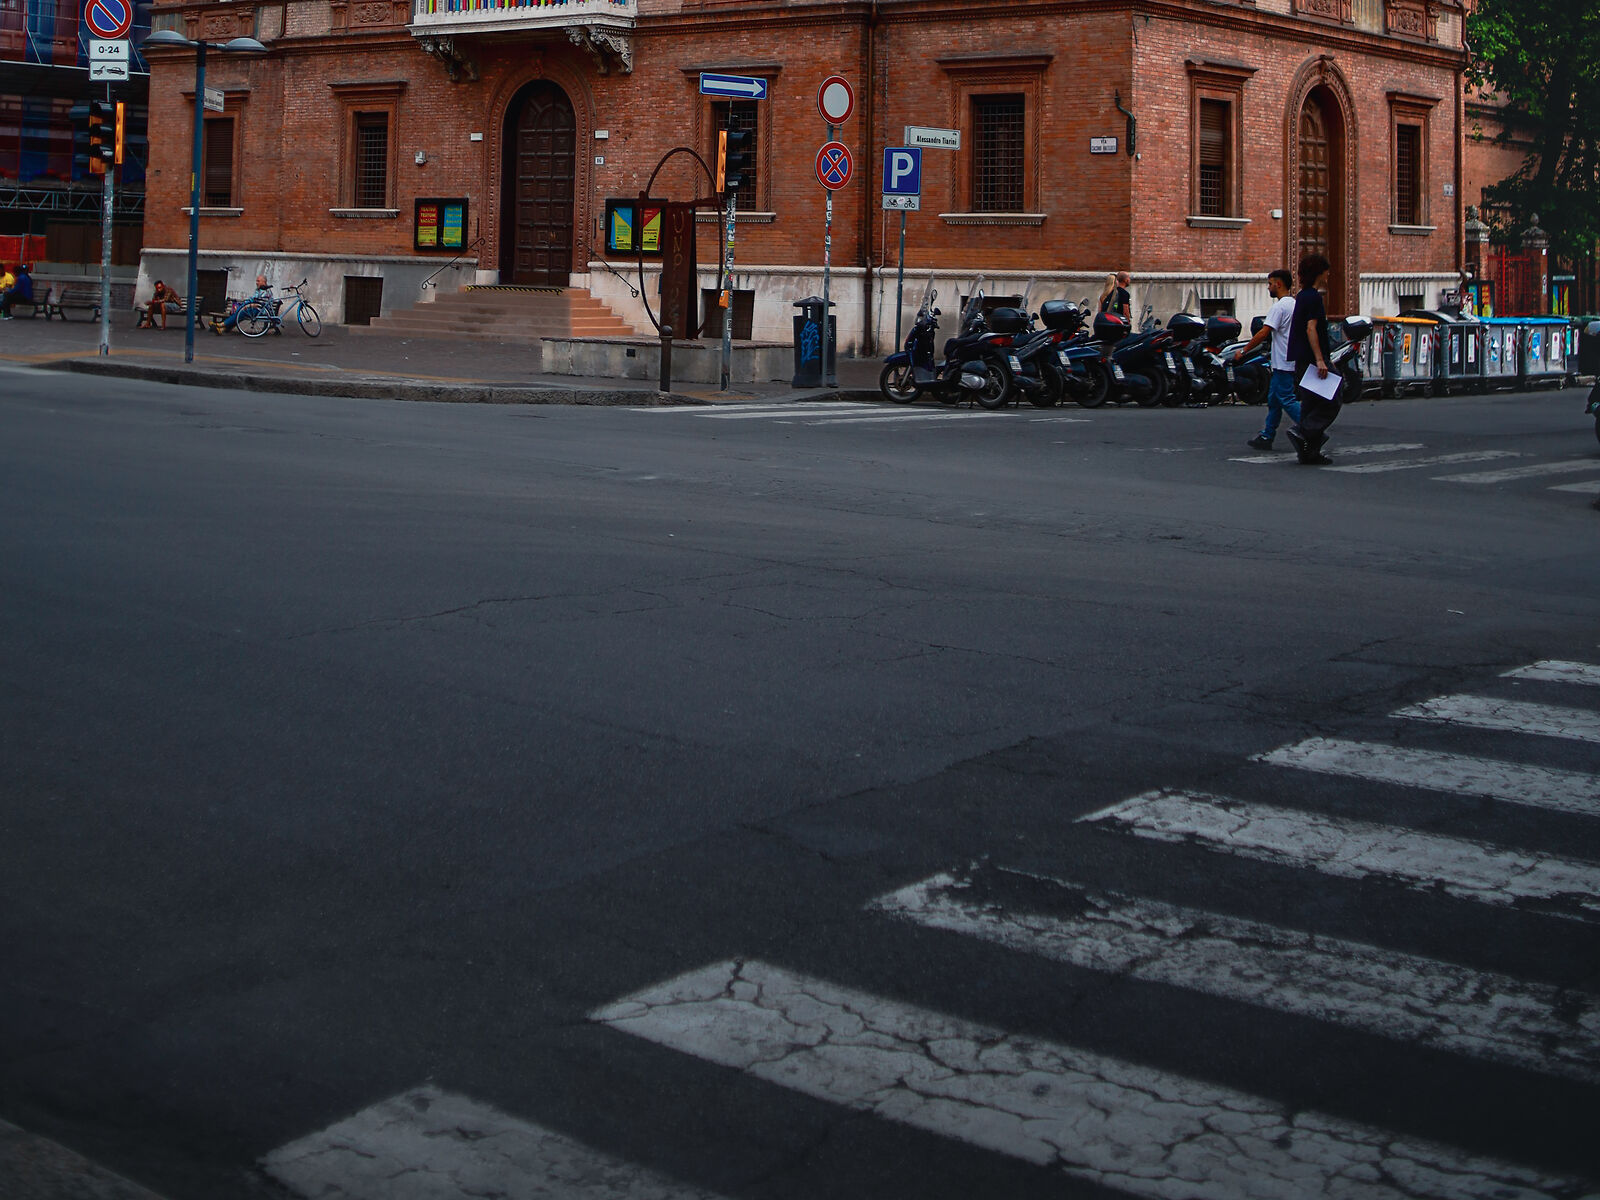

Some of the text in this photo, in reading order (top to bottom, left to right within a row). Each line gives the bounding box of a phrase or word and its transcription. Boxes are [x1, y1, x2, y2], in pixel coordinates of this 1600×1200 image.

[98, 46, 120, 54] 0-24
[916, 135, 957, 146] Alessandro Tiarini
[890, 152, 914, 189] P
